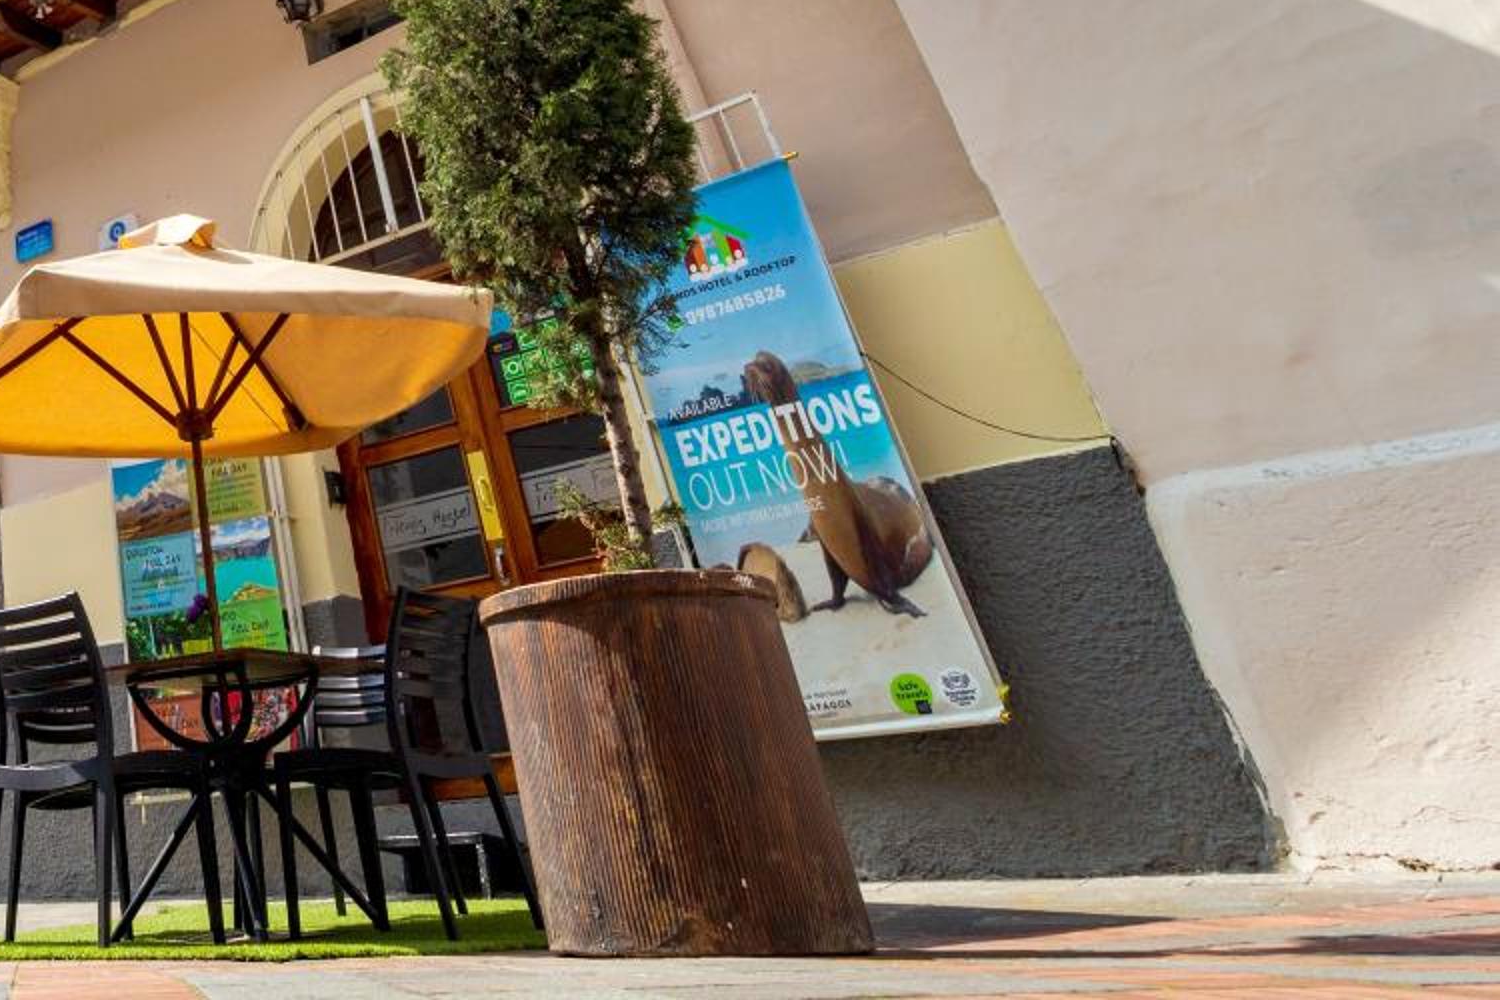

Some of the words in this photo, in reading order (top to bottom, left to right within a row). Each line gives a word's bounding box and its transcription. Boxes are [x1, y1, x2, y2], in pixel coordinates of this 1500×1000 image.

[698, 274, 733, 294] HOTEL
[744, 255, 797, 280] ROOFTOP
[668, 394, 733, 421] AVAILABLE
[675, 384, 882, 468] EXPEDITIONS
[689, 461, 752, 512] OUT
[759, 439, 853, 497] NOW!
